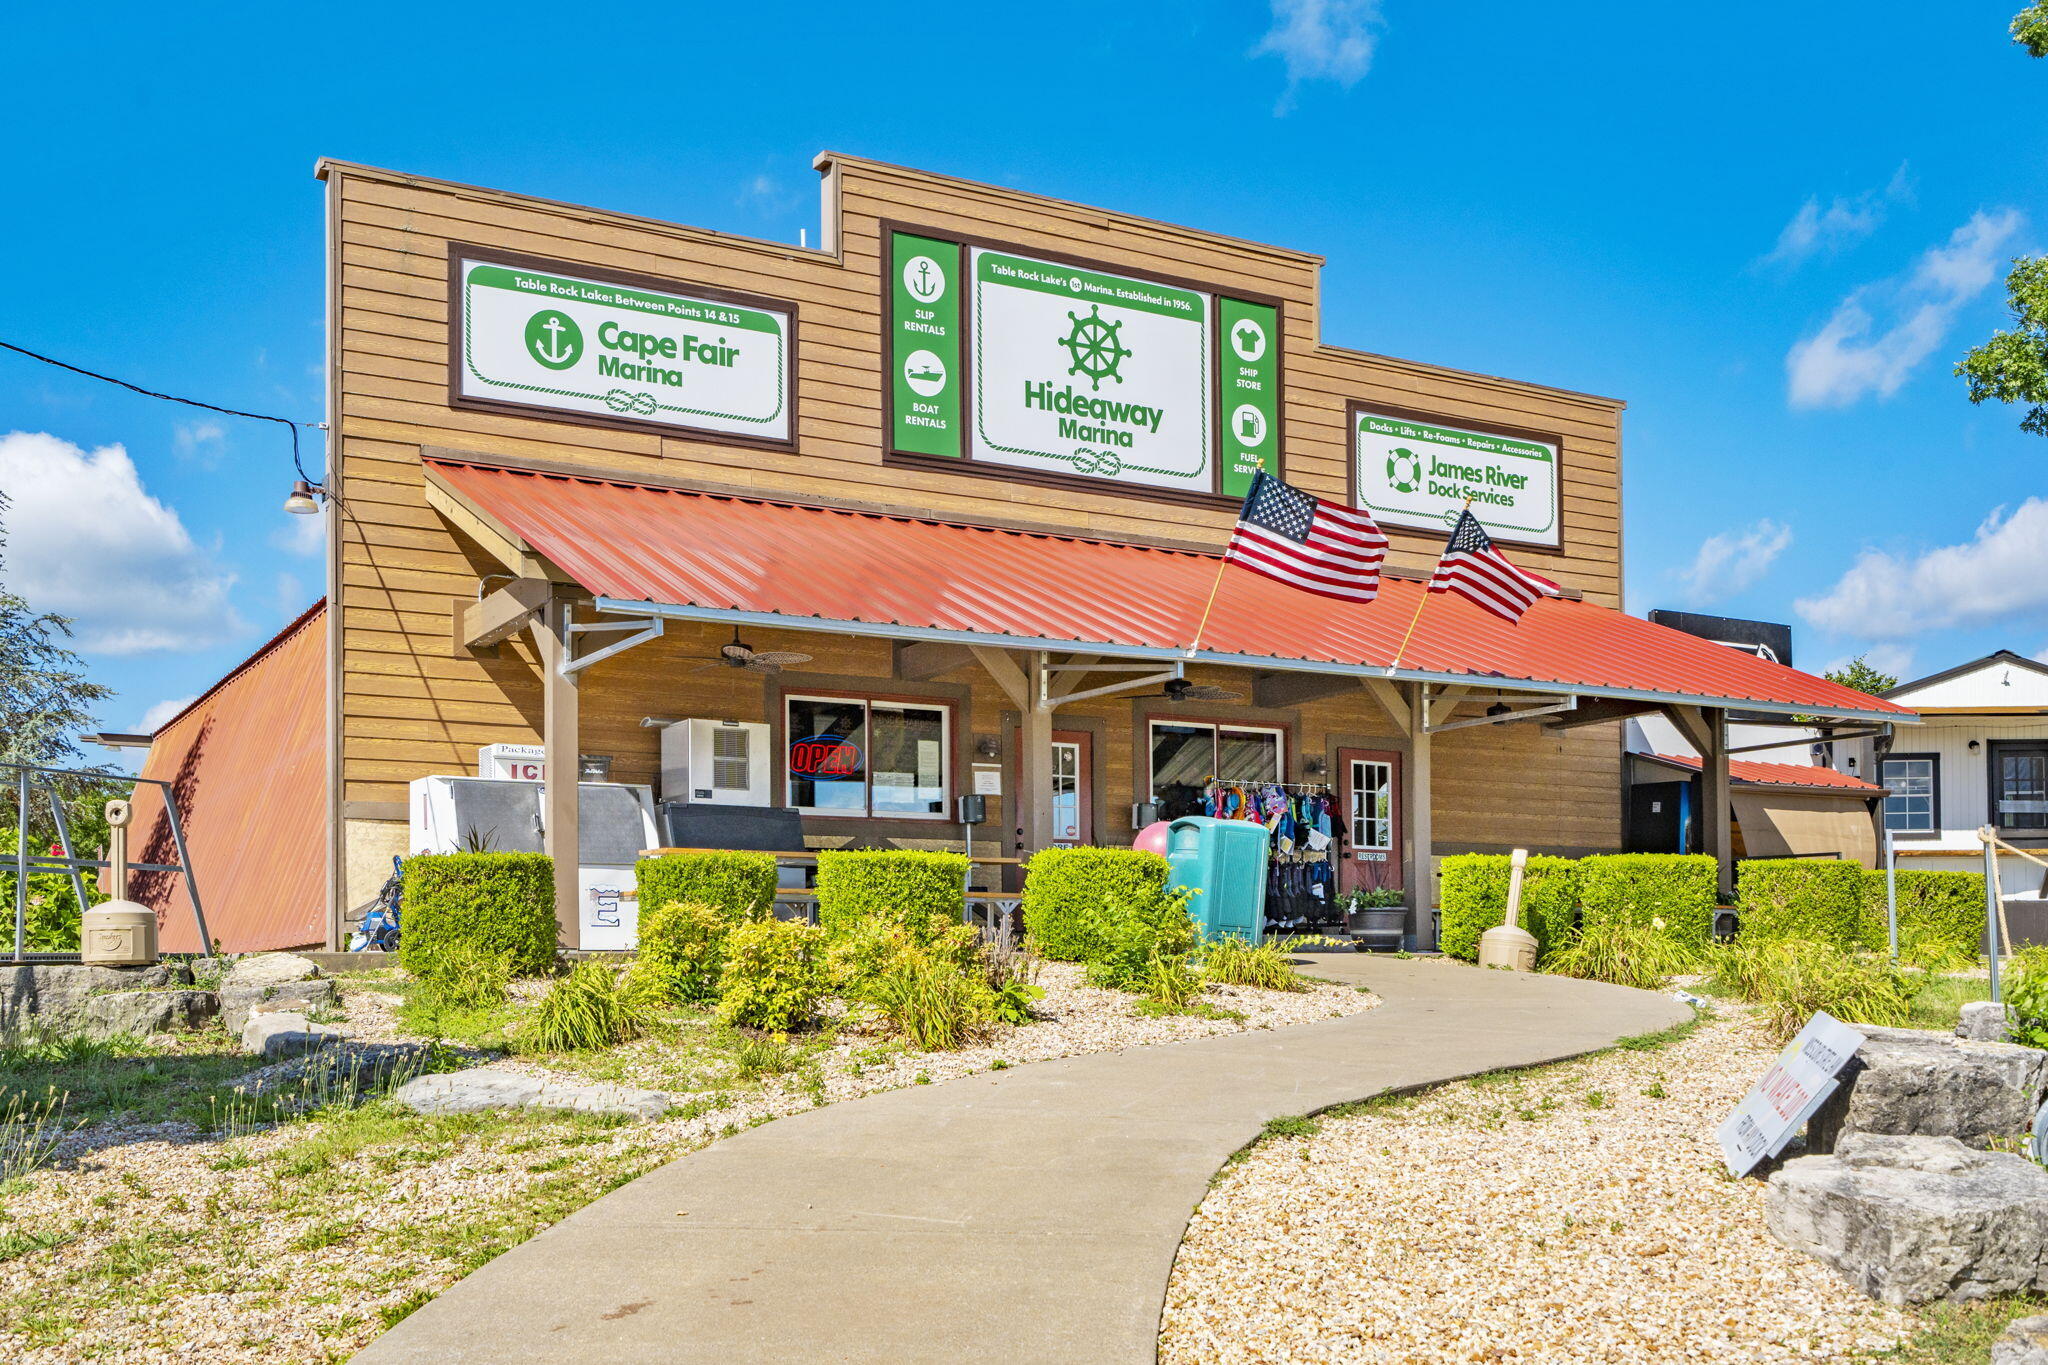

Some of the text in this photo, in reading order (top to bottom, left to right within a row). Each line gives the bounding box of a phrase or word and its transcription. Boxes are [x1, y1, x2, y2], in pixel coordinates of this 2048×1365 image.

[514, 277, 547, 292] Table
[550, 282, 579, 298] Rock
[581, 287, 613, 302] Lake:
[615, 294, 665, 312] Between
[667, 303, 701, 317] Points
[704, 309, 717, 321] 14
[991, 264, 1016, 278] Table
[1018, 269, 1040, 282] Rock
[1041, 273, 1067, 287] Lake's
[1084, 282, 1115, 296] Marina.
[1116, 289, 1162, 305] Established
[1163, 297, 1171, 307] in
[1173, 299, 1193, 311] 1956.
[904, 321, 945, 337] RENTALS
[915, 309, 934, 321] SLIP
[598, 320, 740, 368] Cape Fair
[599, 354, 683, 388] Marina
[1236, 378, 1262, 391] STORE
[1239, 366, 1258, 378] SHIP
[913, 402, 939, 415] BOAT
[1024, 380, 1164, 434] Hideaway
[905, 415, 946, 430] RENTALS
[1058, 416, 1133, 448] Marina
[1369, 421, 1542, 458] Docks Lifts Re-Foams Repairs Accessories
[1240, 453, 1259, 463] FUEL
[1428, 455, 1528, 490] James River
[1428, 480, 1514, 507] Dock Services
[511, 763, 545, 780] IC
[791, 743, 857, 775] OPEN
